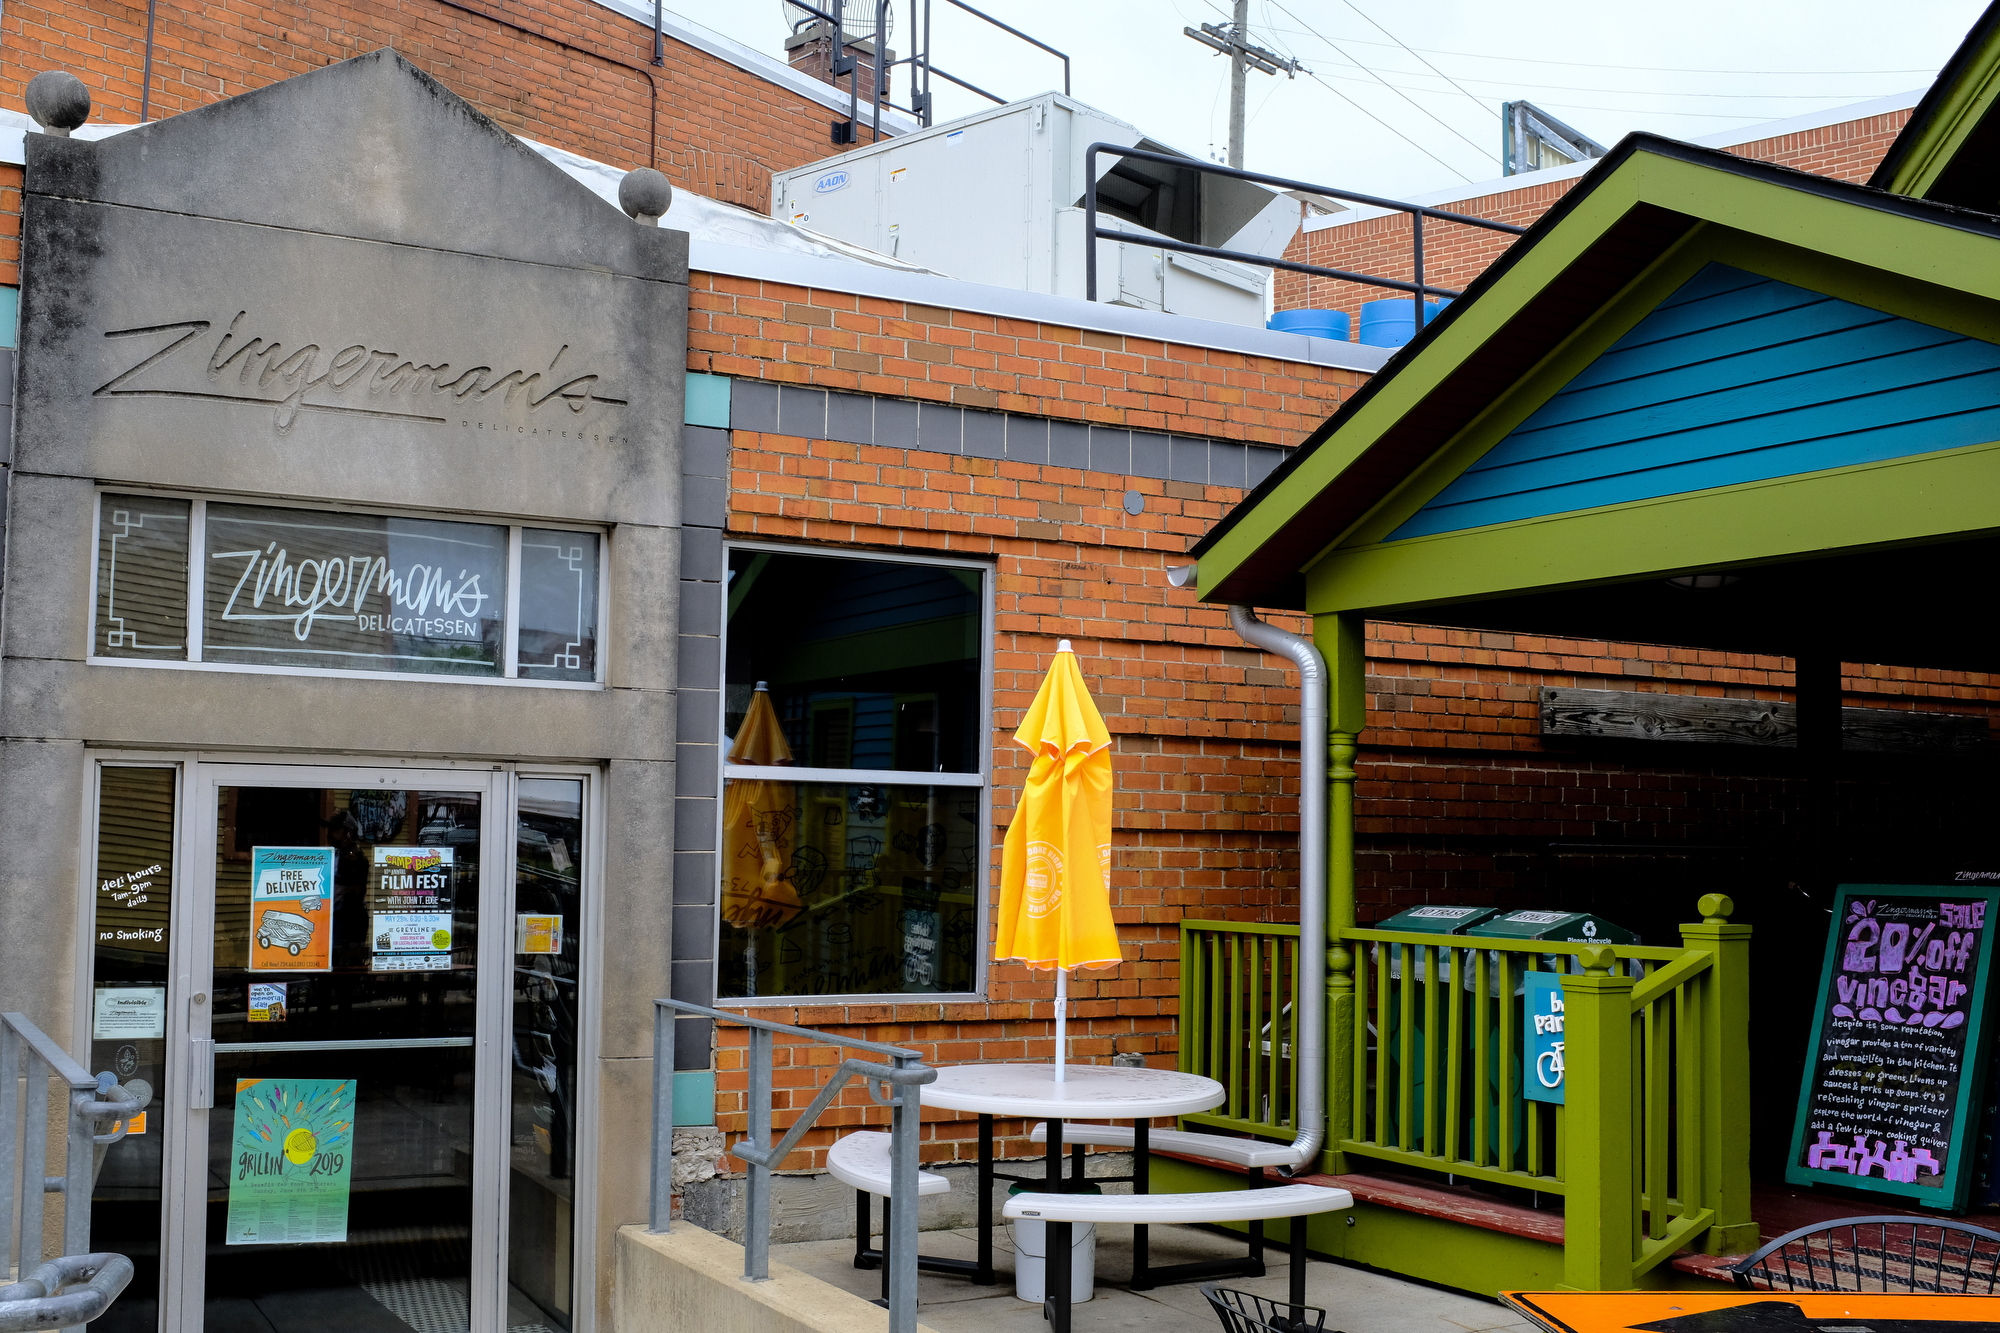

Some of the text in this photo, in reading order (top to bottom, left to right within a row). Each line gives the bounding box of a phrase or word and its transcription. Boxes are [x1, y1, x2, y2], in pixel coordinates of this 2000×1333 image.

[92, 310, 628, 436] Zingerman's
[462, 420, 628, 444] DELICATESSEN
[212, 541, 489, 641] Zingerman's
[359, 614, 477, 637] DELICATESSEN
[386, 855, 441, 870] CAMP BACON
[1027, 846, 1063, 874] DONE RIGHT
[127, 864, 162, 883] hours
[281, 870, 303, 880] FREE
[381, 874, 447, 889] FILM FEST
[111, 881, 152, 901] 7am-9pm
[266, 880, 317, 895] DELIVERY
[387, 896, 401, 904] WITH
[403, 896, 417, 904] JOHN
[100, 932, 113, 940] no
[1843, 917, 1974, 974] 20% off
[1837, 965, 1968, 1012] vinegar
[1832, 1019, 1863, 1030] despite
[1901, 1026, 1944, 1039] reputation,
[1827, 1038, 1859, 1048] vinegar
[1862, 1039, 1891, 1048] provides
[1925, 1045, 1956, 1057] variety
[1840, 1054, 1883, 1066] versatility
[1898, 1057, 1911, 1066] the
[1914, 1059, 1947, 1070] kitchen.
[1950, 1063, 1957, 1072] it
[1829, 1067, 1861, 1077] dresses
[1866, 1072, 1875, 1080] up
[1878, 1072, 1908, 1084] greens,
[1823, 1080, 1851, 1089] sauces
[1853, 1082, 1858, 1090] &
[1861, 1085, 1881, 1094] perks
[1885, 1089, 1894, 1097] up
[1922, 1092, 1935, 1102] try
[1818, 1093, 1948, 1118] refreshing vinegar spritzer!
[1814, 1108, 1940, 1133] explore the world of vinegar &
[1836, 1123, 1851, 1132] few
[1853, 1124, 1862, 1133] to
[1865, 1128, 1883, 1138] your
[1887, 1131, 1917, 1145] cooking
[310, 1152, 344, 1176] 2019
